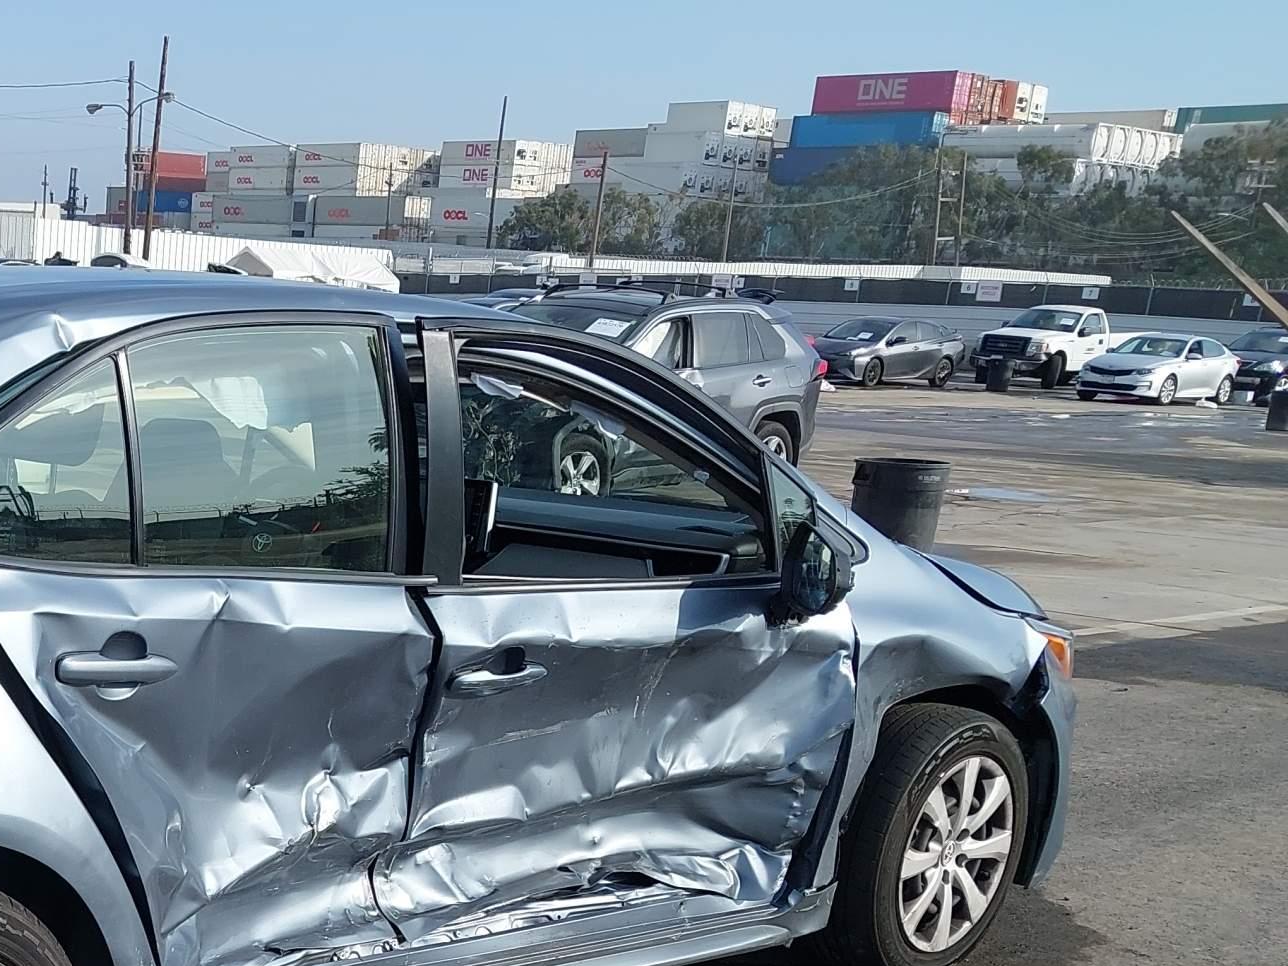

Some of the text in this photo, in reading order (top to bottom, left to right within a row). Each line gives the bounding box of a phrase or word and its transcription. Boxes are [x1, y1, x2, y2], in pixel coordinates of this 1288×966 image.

[857, 78, 909, 100] ONE
[465, 143, 491, 157] ONE
[238, 155, 253, 163] OOCL
[305, 153, 322, 161] OOCL
[462, 168, 488, 182] ONE
[584, 169, 602, 178] OOC
[237, 176, 252, 184] OOCL
[303, 176, 320, 184] OOCL
[443, 209, 468, 220] OOCL
